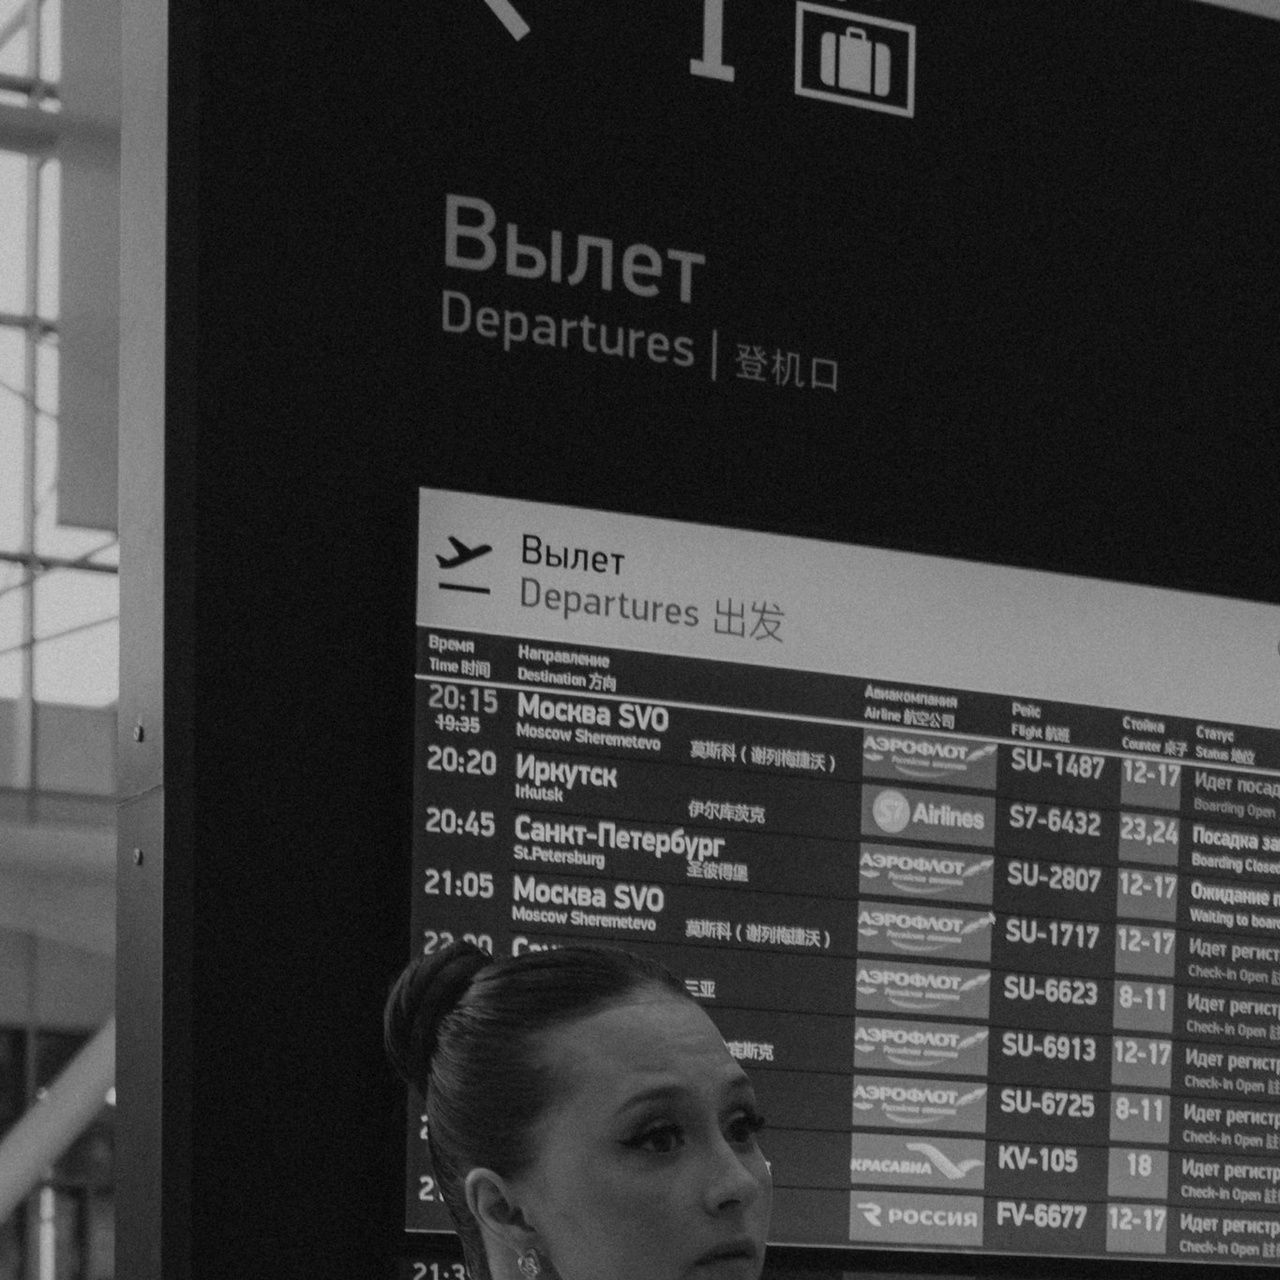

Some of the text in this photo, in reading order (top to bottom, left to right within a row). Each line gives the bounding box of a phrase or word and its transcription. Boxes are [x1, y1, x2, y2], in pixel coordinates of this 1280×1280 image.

[444, 193, 706, 304] Вылет
[442, 290, 839, 392] Departures 登机口
[522, 534, 625, 575] Вылет
[520, 577, 784, 643] Departures 出发
[428, 634, 475, 653] Время
[518, 644, 609, 669] Направление
[429, 657, 459, 673] Time
[518, 667, 586, 687] Destination
[428, 683, 498, 714] 20:15
[865, 684, 957, 709] Авиакомпания
[518, 691, 669, 731] Москва SVO
[864, 706, 901, 723] Airline
[1011, 702, 1041, 719] Рейс
[516, 722, 661, 751] Moscow Sheremetevo
[1011, 723, 1043, 741] Flight
[1122, 716, 1165, 734] Стойка
[1196, 724, 1234, 743] Статус
[863, 735, 968, 760] АЭРОФЛОТ
[1122, 736, 1162, 754] Counter
[1195, 745, 1228, 761] Status
[427, 744, 497, 776] 20:20
[516, 752, 617, 789] Иркутск
[1011, 746, 1105, 780] SU-1487
[1123, 760, 1181, 787] 12-17
[515, 783, 563, 802] Irkutsk
[1195, 771, 1233, 791] Идет
[425, 806, 495, 837] 20:45
[912, 802, 985, 830] Airlines
[1010, 803, 1101, 837] S7-6432
[1193, 797, 1244, 818] Boarding
[1248, 803, 1276, 821] Open
[514, 814, 726, 860] Санкт-Петербург
[1120, 816, 1178, 846] 23,24
[1193, 824, 1259, 850] Посадка
[513, 844, 605, 870] St.Petersburg
[859, 852, 965, 877] АЭРОФЛОТ
[1191, 851, 1243, 874] Boarding
[424, 868, 494, 899] 21:05
[1007, 861, 1101, 894] SU-2807
[1120, 871, 1177, 899] 12-17
[513, 875, 665, 912] Москва SVO
[1191, 882, 1270, 906] Ожидание
[512, 905, 656, 931] Moscow Sheremetevo
[1190, 908, 1234, 929] Waiting
[1236, 913, 1249, 927] to
[1006, 917, 1099, 949] SU-1717
[1118, 927, 1175, 955] 12-17
[1189, 937, 1227, 958] Идет
[1188, 964, 1268, 985] Check-in Open
[1004, 975, 1098, 1006] SU-6623
[1119, 985, 1166, 1012] 8-11
[1002, 1032, 1096, 1062] SU-6913
[1115, 1039, 1172, 1066] 12-17
[1000, 1090, 1095, 1118] SU-6725
[1115, 1096, 1163, 1123] 8-11
[998, 1145, 1078, 1173] KV-105
[1127, 1153, 1152, 1177] 18
[888, 1208, 978, 1228] РОССИЯ
[997, 1201, 1087, 1229] FV-6677
[1109, 1206, 1167, 1232] 12-17
[1180, 1213, 1219, 1234] Идет
